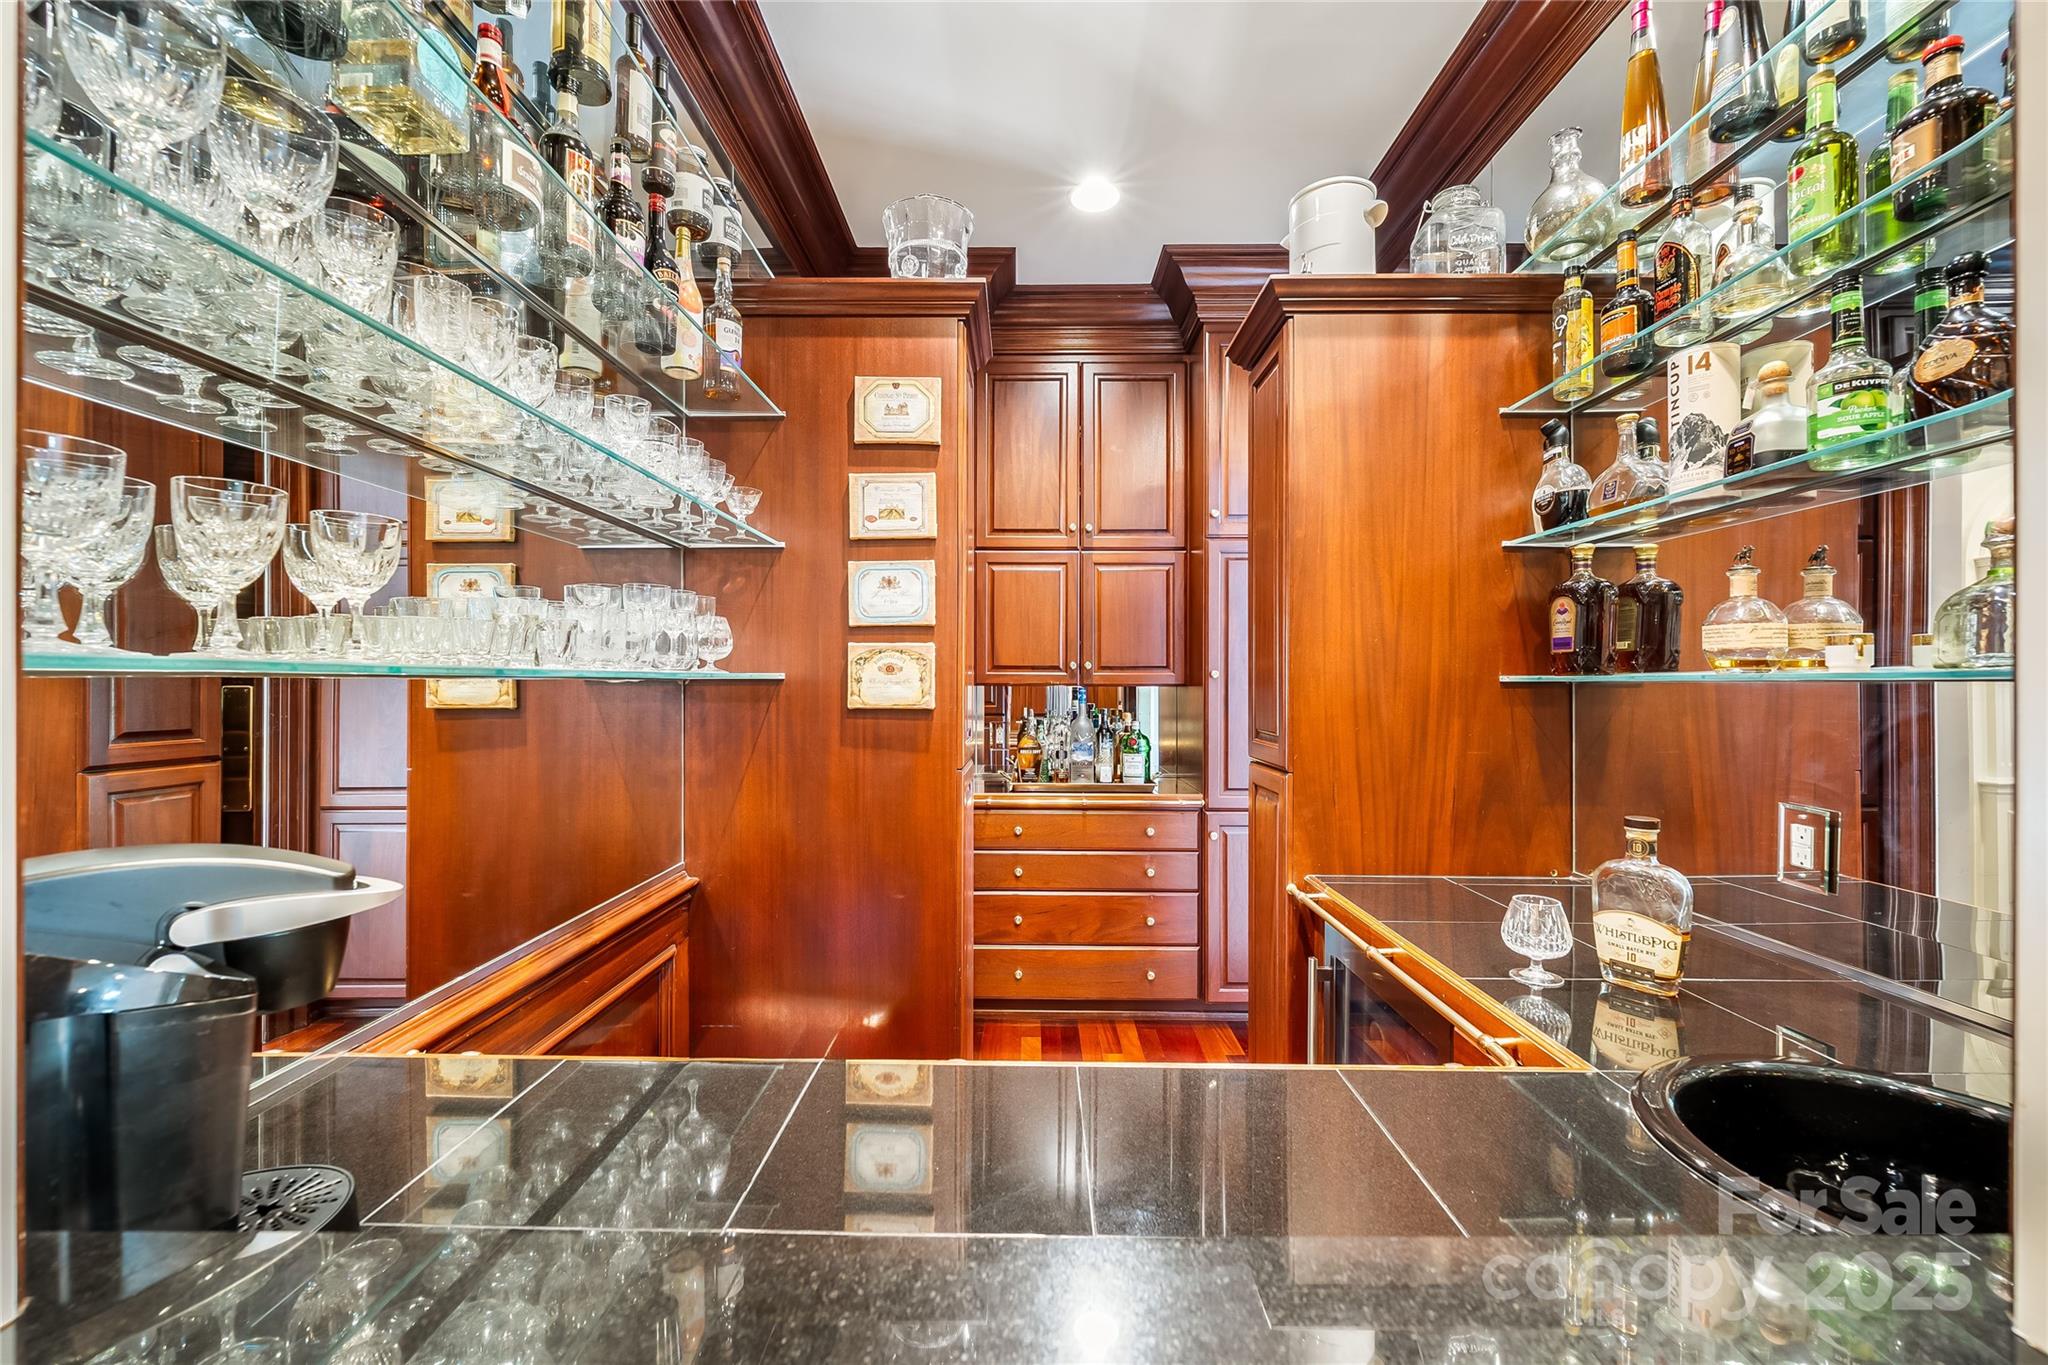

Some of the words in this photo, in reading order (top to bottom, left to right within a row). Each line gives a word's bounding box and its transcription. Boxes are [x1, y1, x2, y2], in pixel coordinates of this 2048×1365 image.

[1688, 351, 1712, 375] 14
[1670, 361, 1680, 430] TINCUP
[1836, 413, 1861, 423] SOUR
[1632, 842, 1643, 853] 10
[1594, 922, 1678, 951] WHISTLEPIG
[1626, 951, 1637, 963] 10
